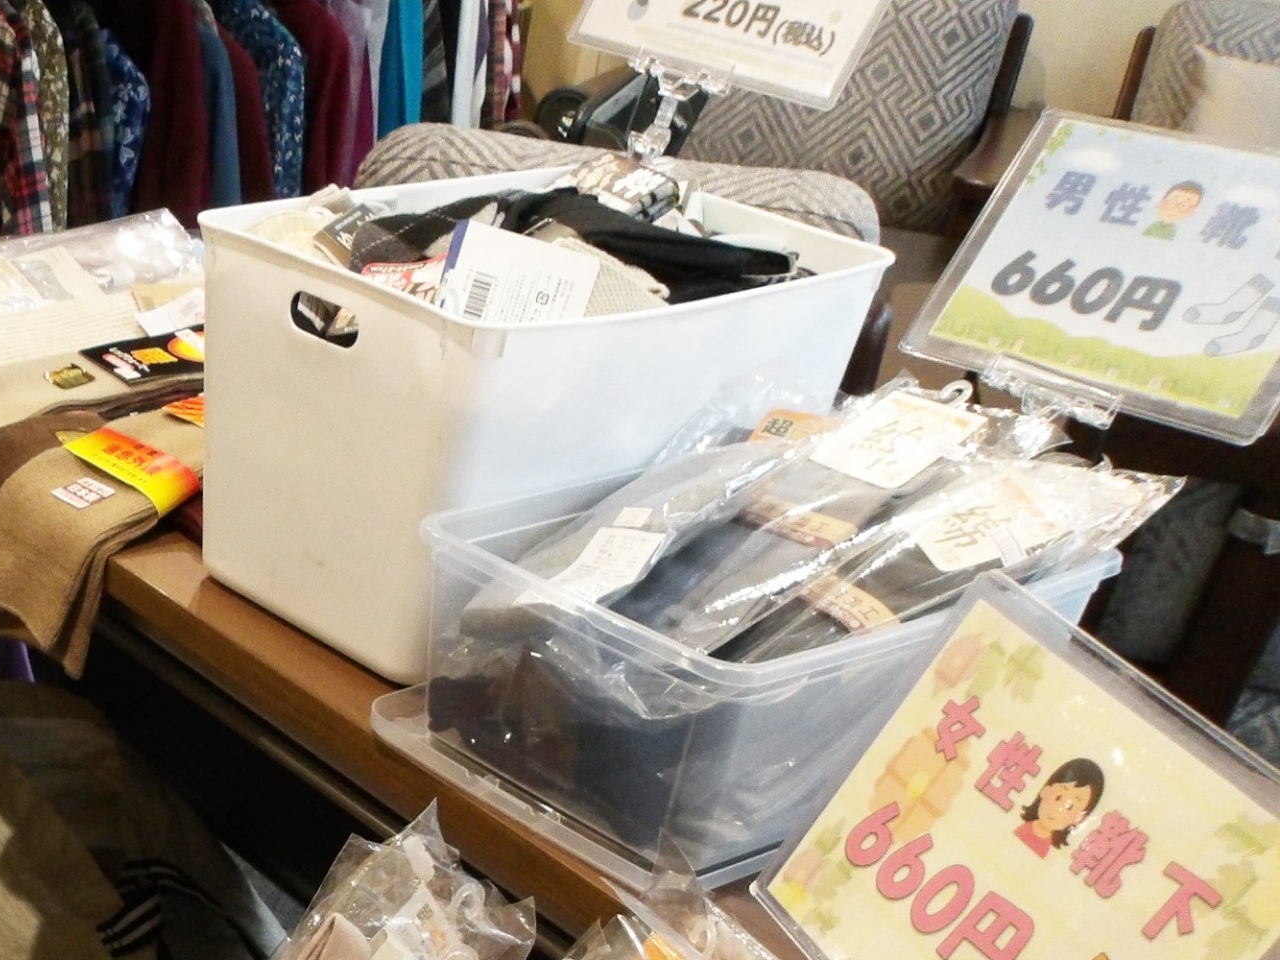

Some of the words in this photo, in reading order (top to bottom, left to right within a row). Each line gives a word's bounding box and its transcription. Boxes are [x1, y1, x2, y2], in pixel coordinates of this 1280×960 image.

[1044, 170, 1153, 228] 男性
[1198, 201, 1280, 261] 靴
[990, 249, 1183, 332] 660円
[935, 694, 1044, 814] 女性
[1068, 809, 1223, 942] 靴下
